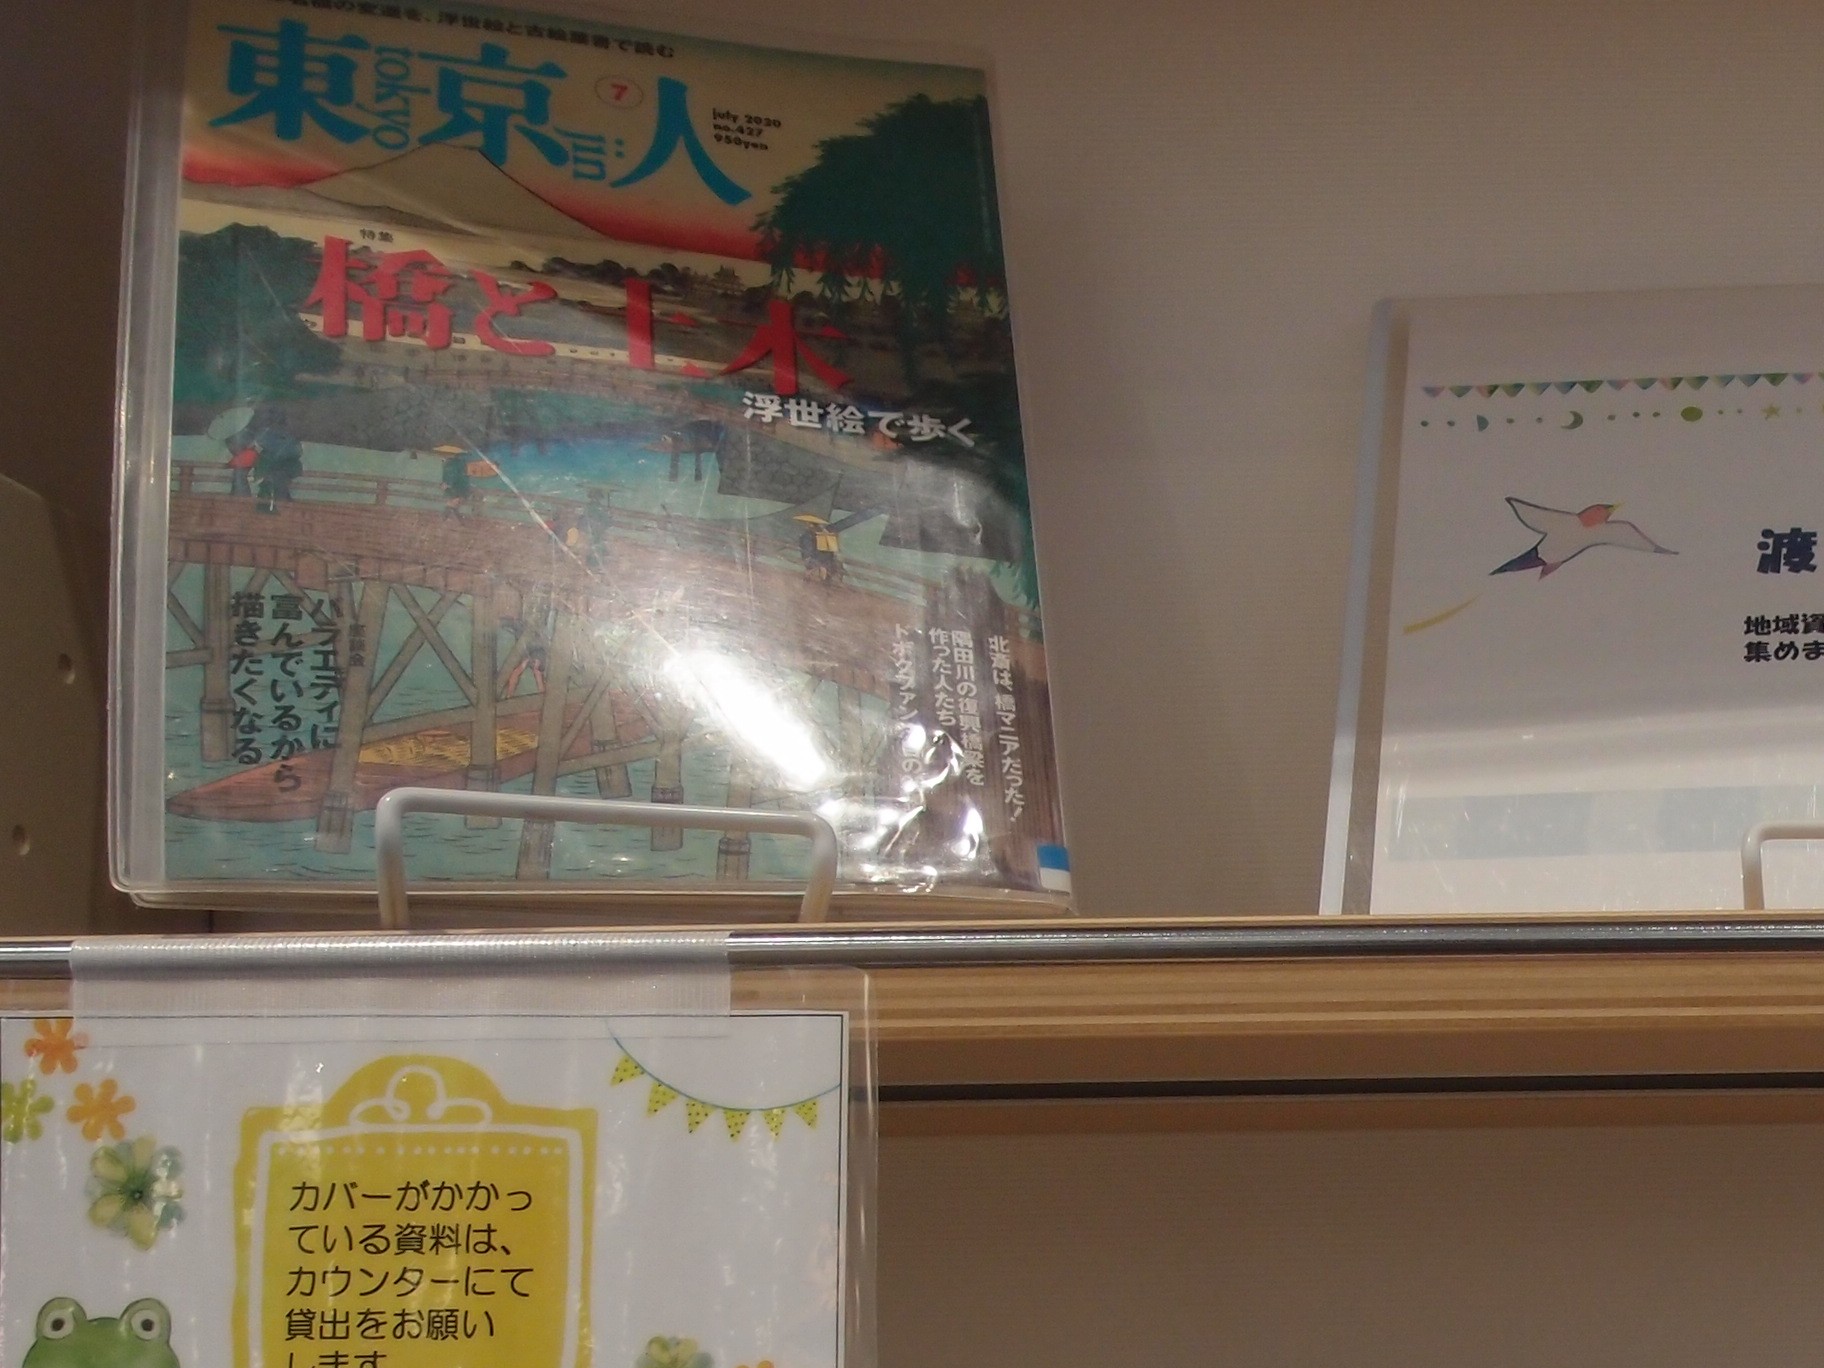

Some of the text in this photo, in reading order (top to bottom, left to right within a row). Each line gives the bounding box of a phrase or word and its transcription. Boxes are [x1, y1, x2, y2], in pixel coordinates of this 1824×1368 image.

[611, 83, 629, 101] 7
[209, 18, 752, 206] 東京人
[359, 227, 394, 243] 特集
[742, 391, 978, 449] 浮世絵で歩く
[231, 591, 265, 766] 描きたくなる
[271, 593, 304, 793] 富んでいるから
[929, 627, 957, 728] 作った人たち
[289, 1179, 535, 1214] カバーがかかっ
[289, 1222, 513, 1257] ている資料は、
[286, 1266, 536, 1299] カウンターにて
[284, 1307, 496, 1343] 貸出をお願い
